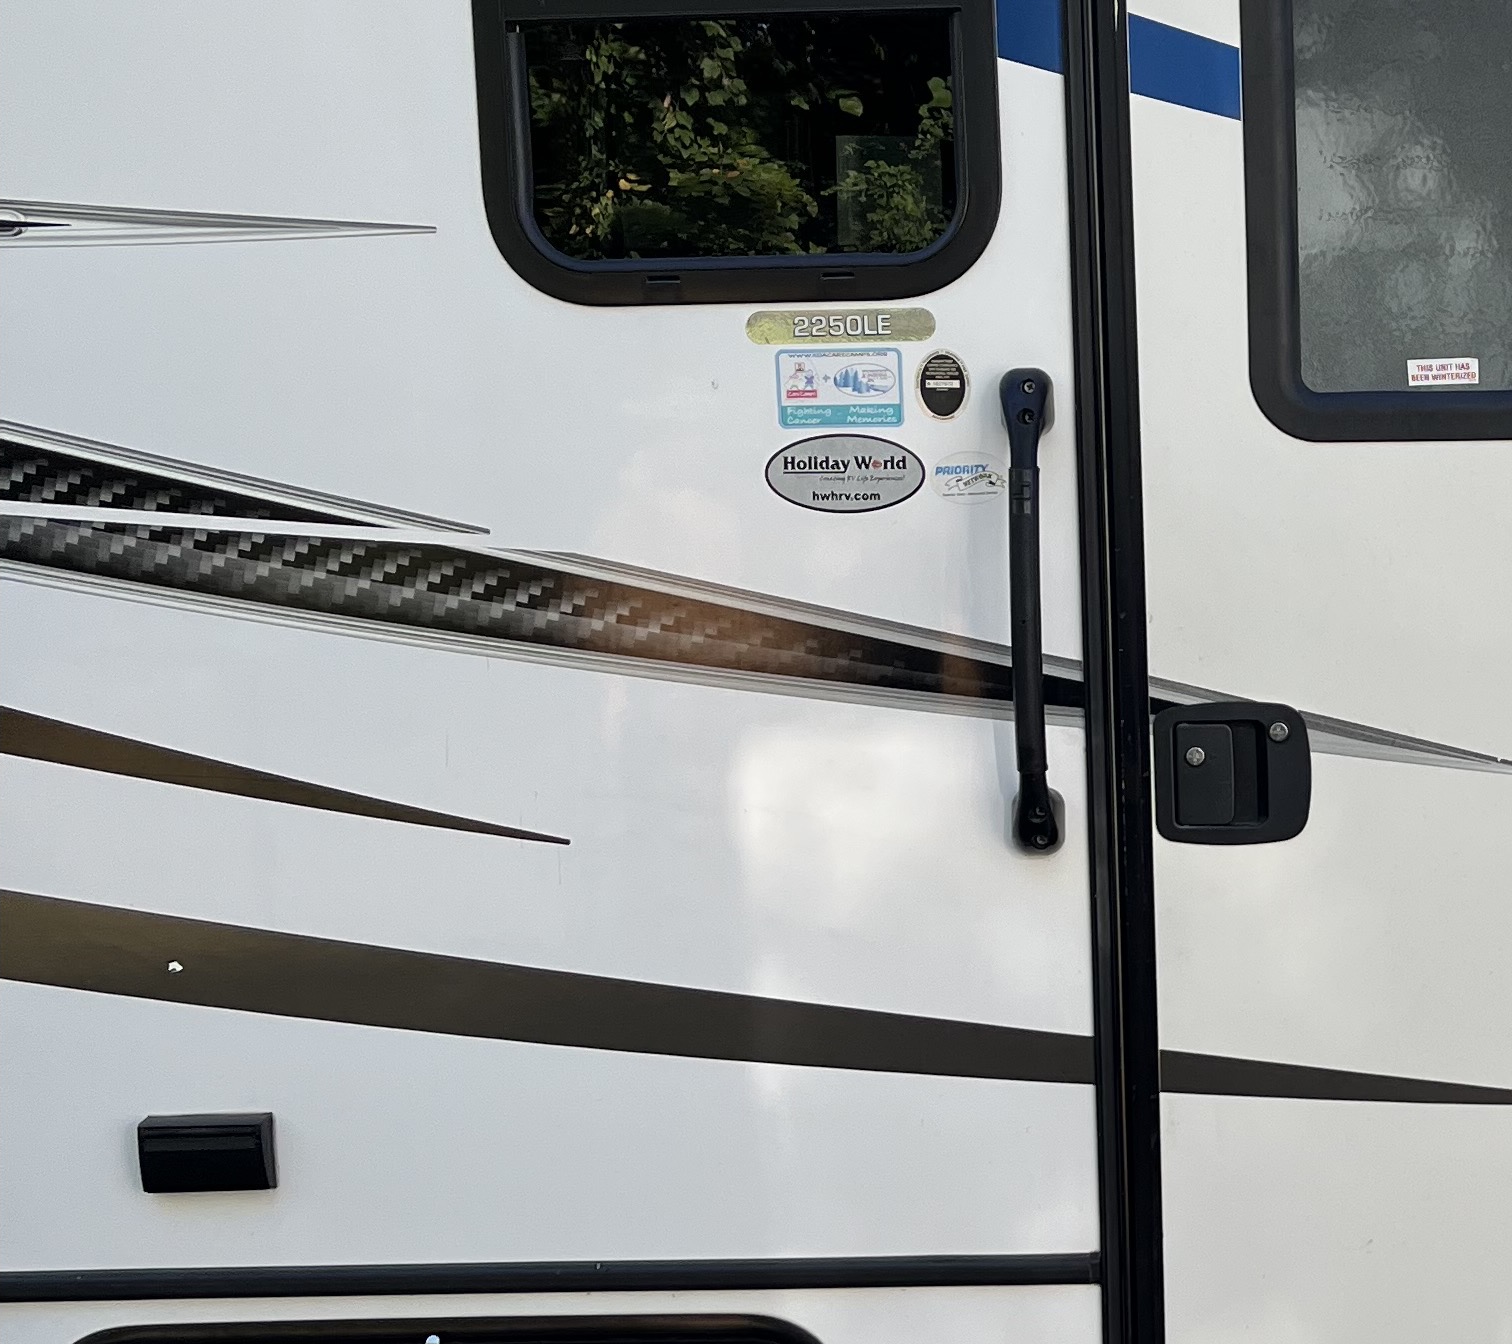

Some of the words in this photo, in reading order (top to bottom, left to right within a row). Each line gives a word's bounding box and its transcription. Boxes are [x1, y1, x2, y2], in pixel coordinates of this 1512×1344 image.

[792, 314, 893, 337] 2250LE
[782, 455, 850, 474] Holiday
[935, 464, 990, 476] PRIORITY
[812, 490, 881, 502] hwhrv.com
